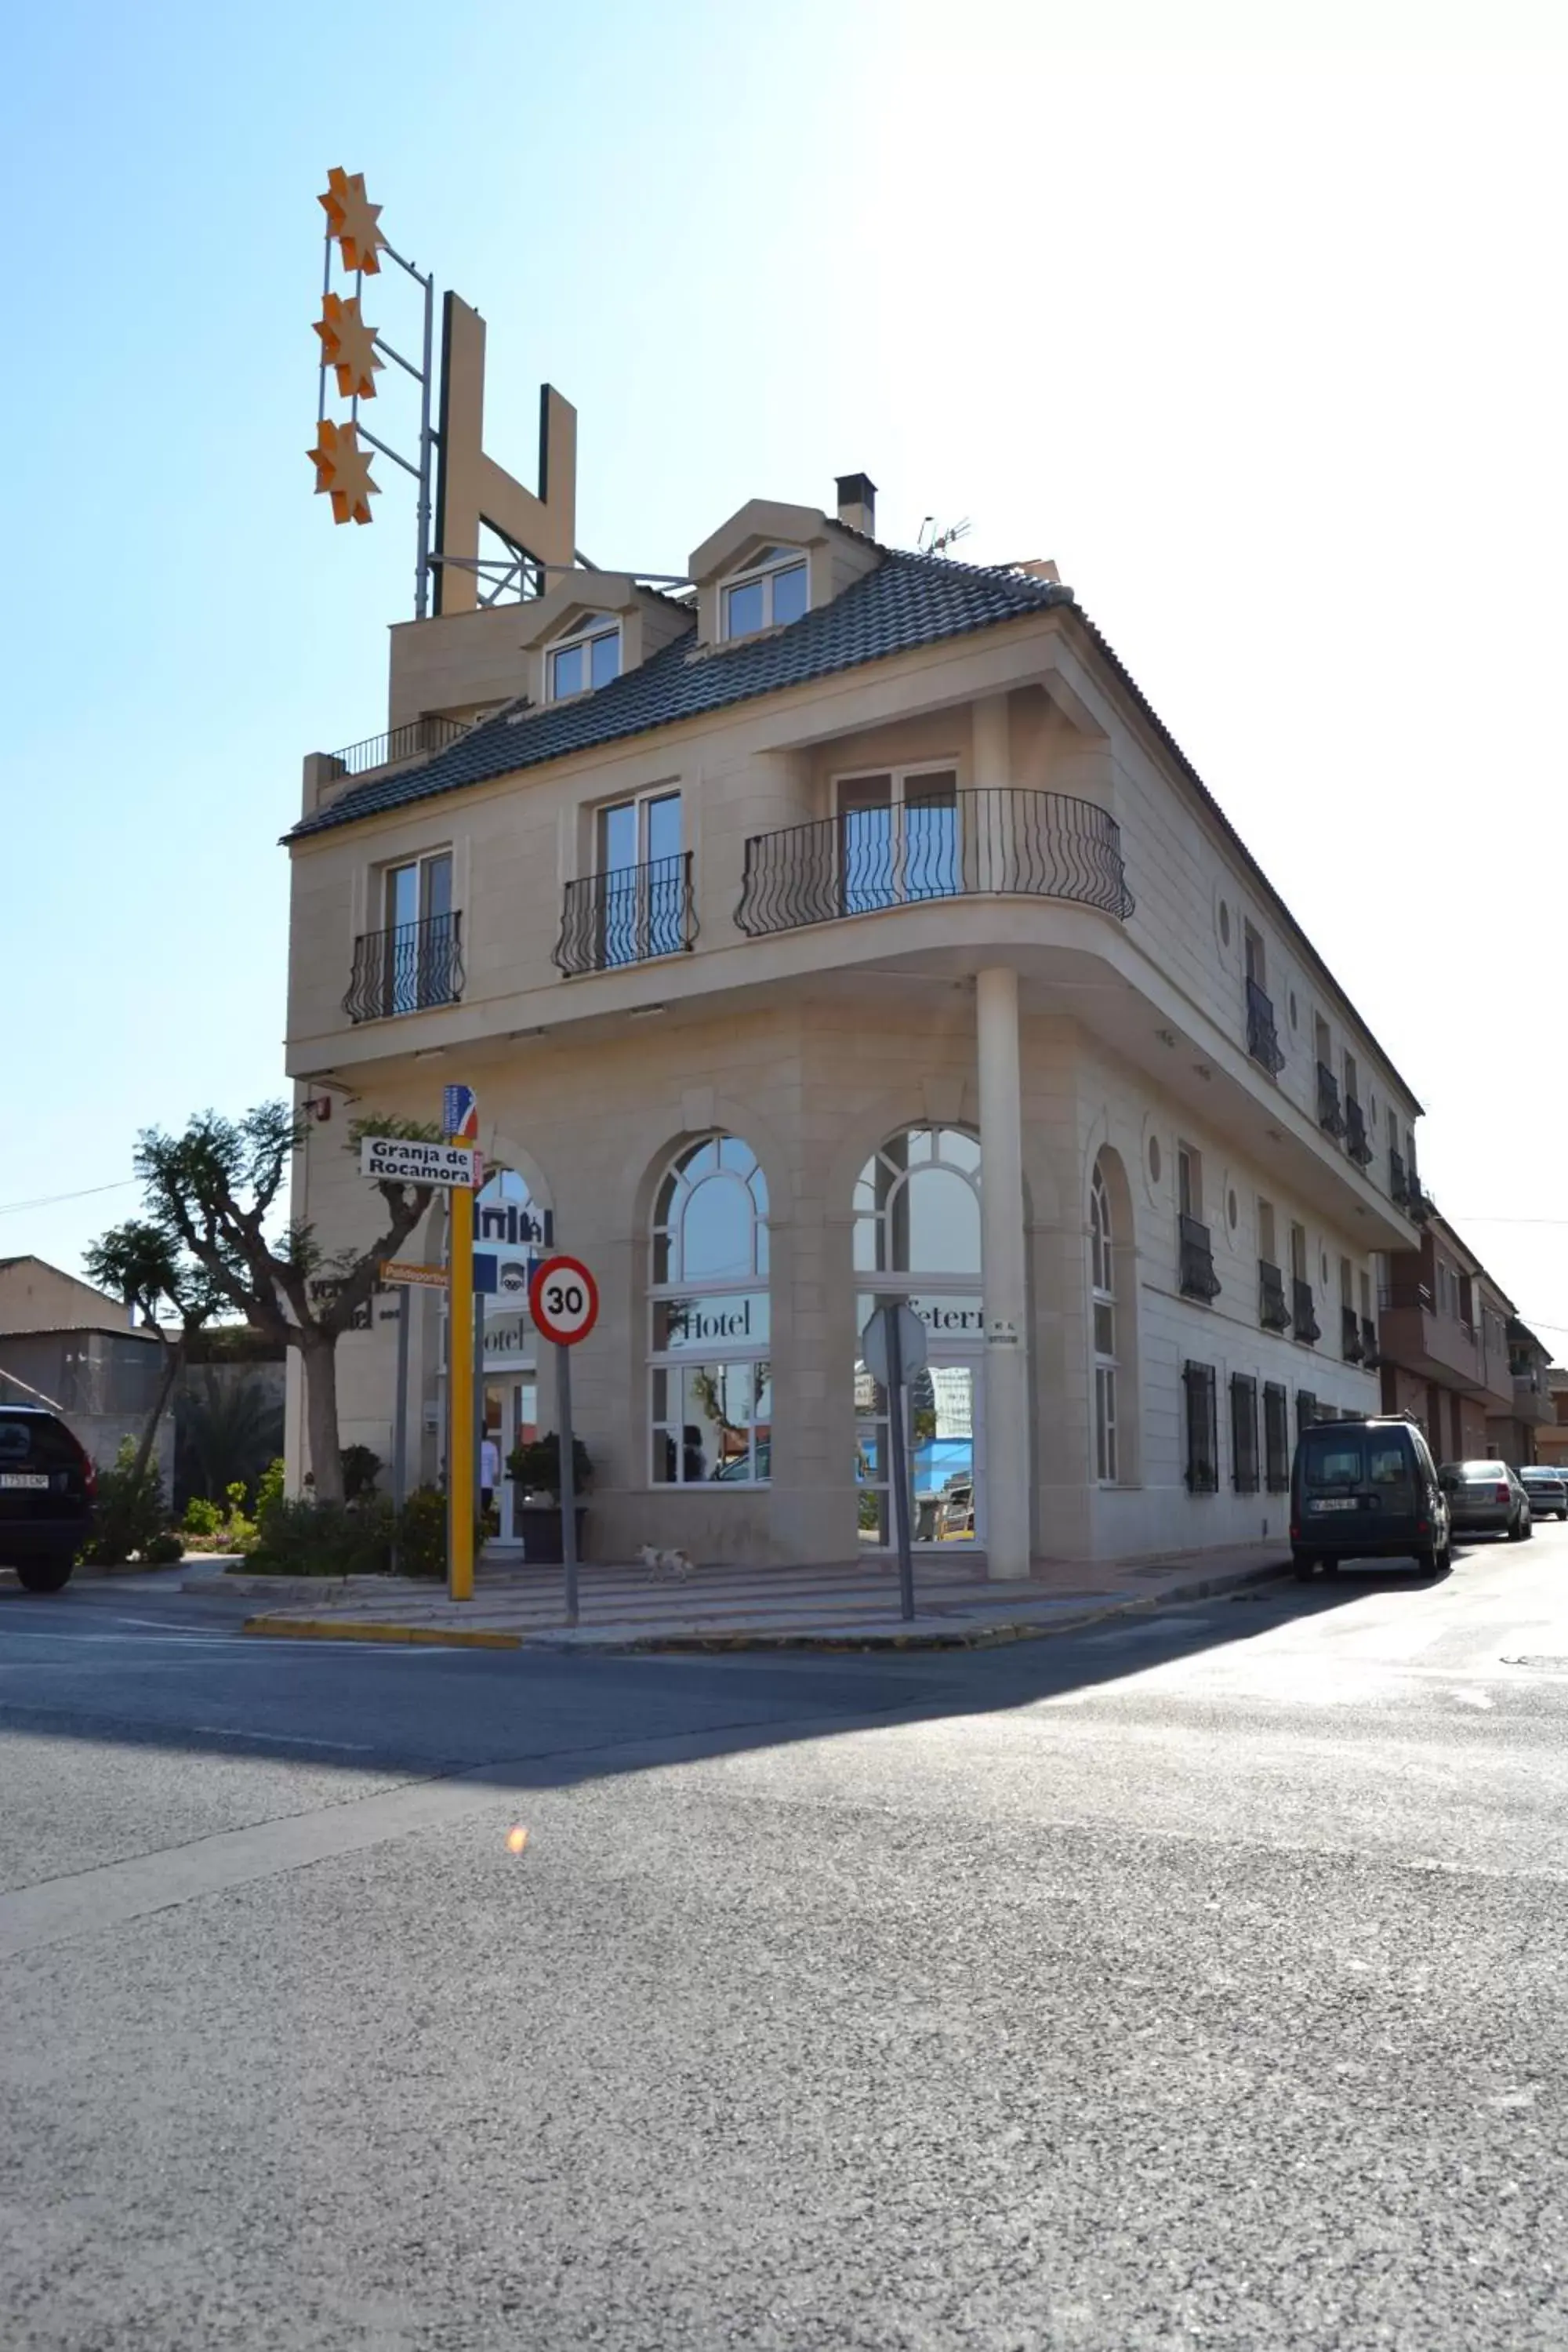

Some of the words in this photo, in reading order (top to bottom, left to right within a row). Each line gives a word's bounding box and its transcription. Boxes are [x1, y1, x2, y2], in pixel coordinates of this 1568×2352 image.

[434, 290, 578, 616] H
[372, 1141, 440, 1164] Granja
[446, 1150, 468, 1165] de
[369, 1158, 470, 1182] Rocamora
[547, 1287, 583, 1315] 30
[684, 1298, 750, 1339] Hotel
[484, 1318, 524, 1352] otel
